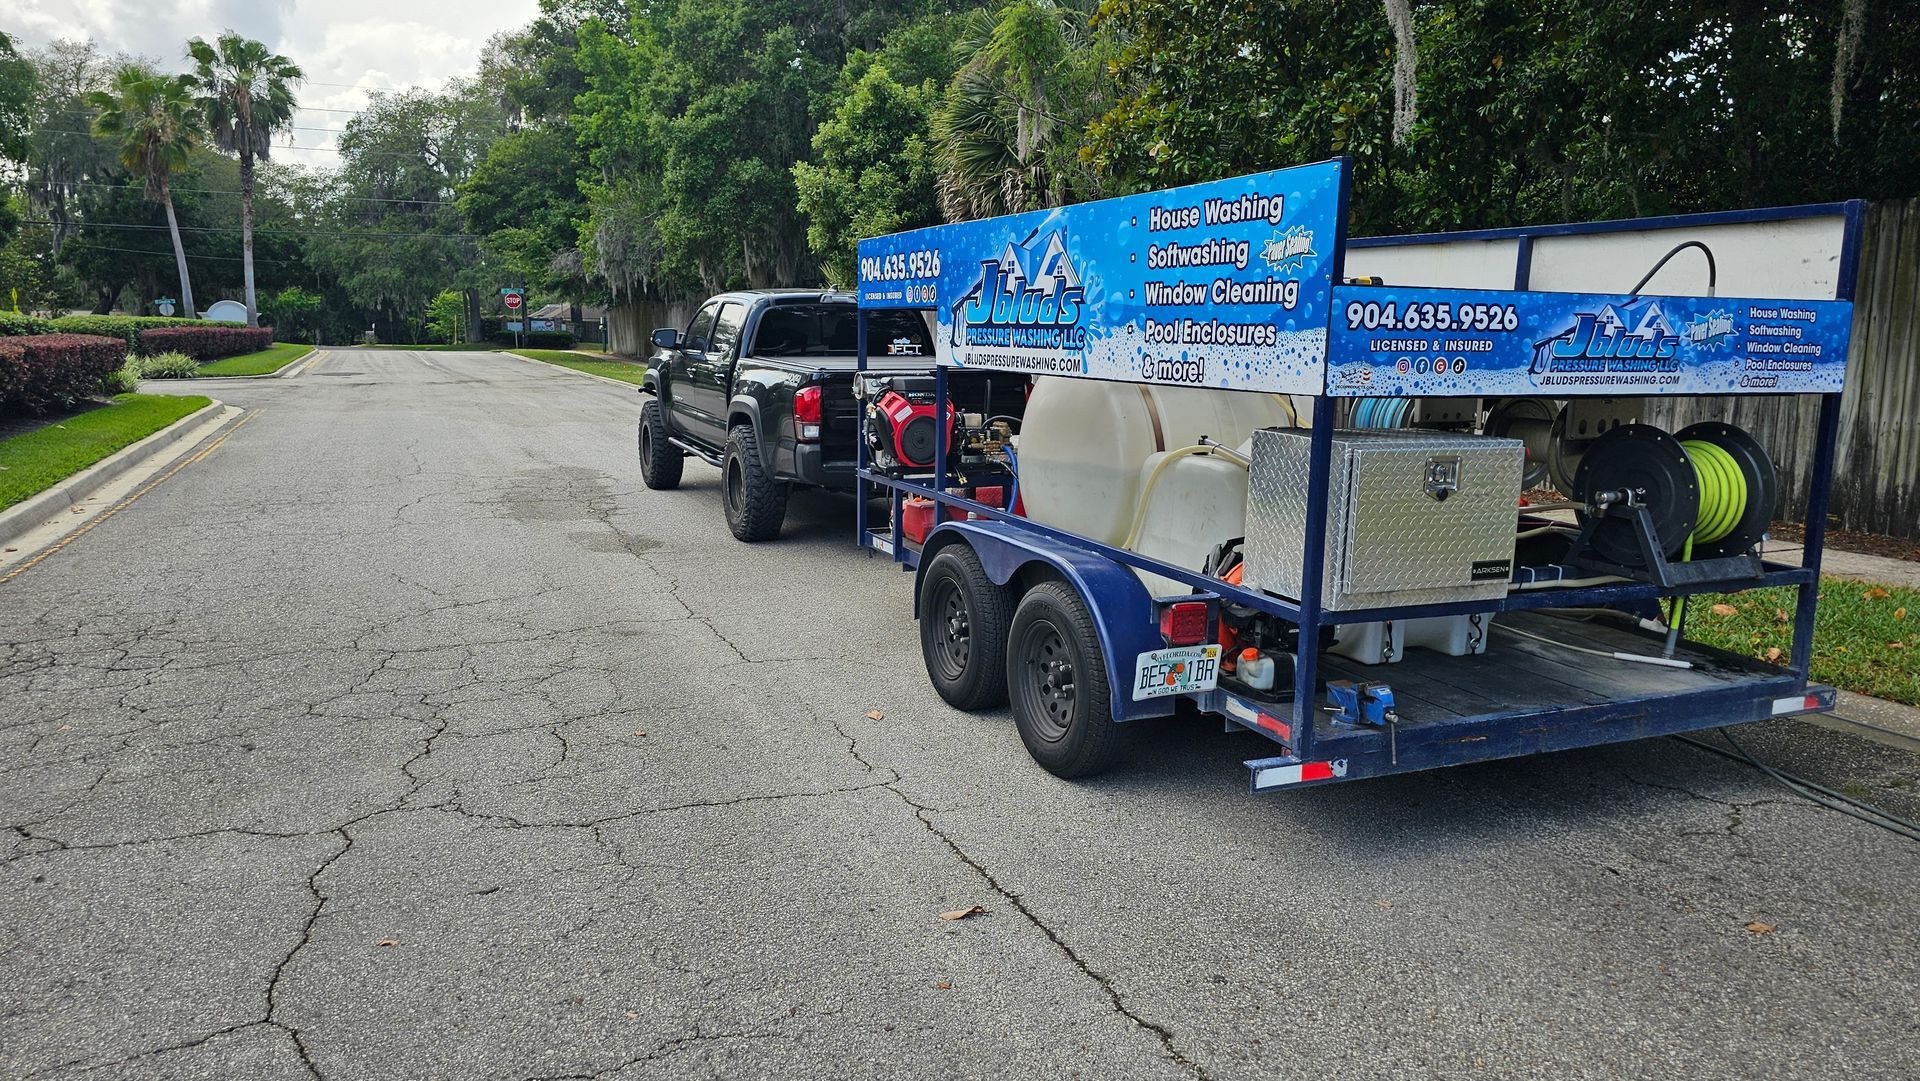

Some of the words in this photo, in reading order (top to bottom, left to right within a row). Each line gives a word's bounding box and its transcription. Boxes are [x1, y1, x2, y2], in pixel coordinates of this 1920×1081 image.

[1149, 207, 1200, 232] House
[1204, 193, 1284, 225] Washing
[1148, 239, 1249, 269] Softwashing
[861, 249, 941, 282] 904.635.9526
[965, 259, 1085, 326] Jbluds
[1145, 280, 1207, 306] Window
[1211, 277, 1299, 310] Cleaning
[1346, 303, 1518, 332] 904.635.9526
[1750, 307, 1778, 319] House
[1780, 308, 1816, 323] Washing
[965, 326, 1010, 348] PRESSURE
[1011, 326, 1061, 349] WASHING
[1062, 326, 1085, 350] LLC
[1145, 320, 1179, 343] Pool
[1182, 320, 1277, 345] Enclosures
[1552, 313, 1681, 359] Jbluds
[1749, 324, 1802, 339] Softwashing
[1370, 339, 1428, 351] LICENSED
[1432, 340, 1440, 351] &
[1445, 340, 1493, 352] INSURED
[1747, 341, 1781, 353] Window
[1783, 342, 1822, 356] Cleaning
[964, 352, 1081, 373] JBLUDSPRESSUREWASHING.COM
[1142, 356, 1154, 379] &
[1157, 356, 1204, 381] more!
[1550, 359, 1605, 373] PRESSURE
[1607, 359, 1656, 373] WASHING
[1657, 359, 1680, 373] LLC
[1746, 359, 1766, 370] Pool
[1767, 359, 1812, 371] Enclosures
[1540, 375, 1680, 386] JBLUDSPRESSUREWASHING.COM
[1741, 375, 1749, 387] &
[1750, 376, 1778, 387] more!
[1476, 566, 1505, 574] ARKSEN
[1157, 687, 1170, 695] GOD
[1180, 683, 1198, 691] TRUST
